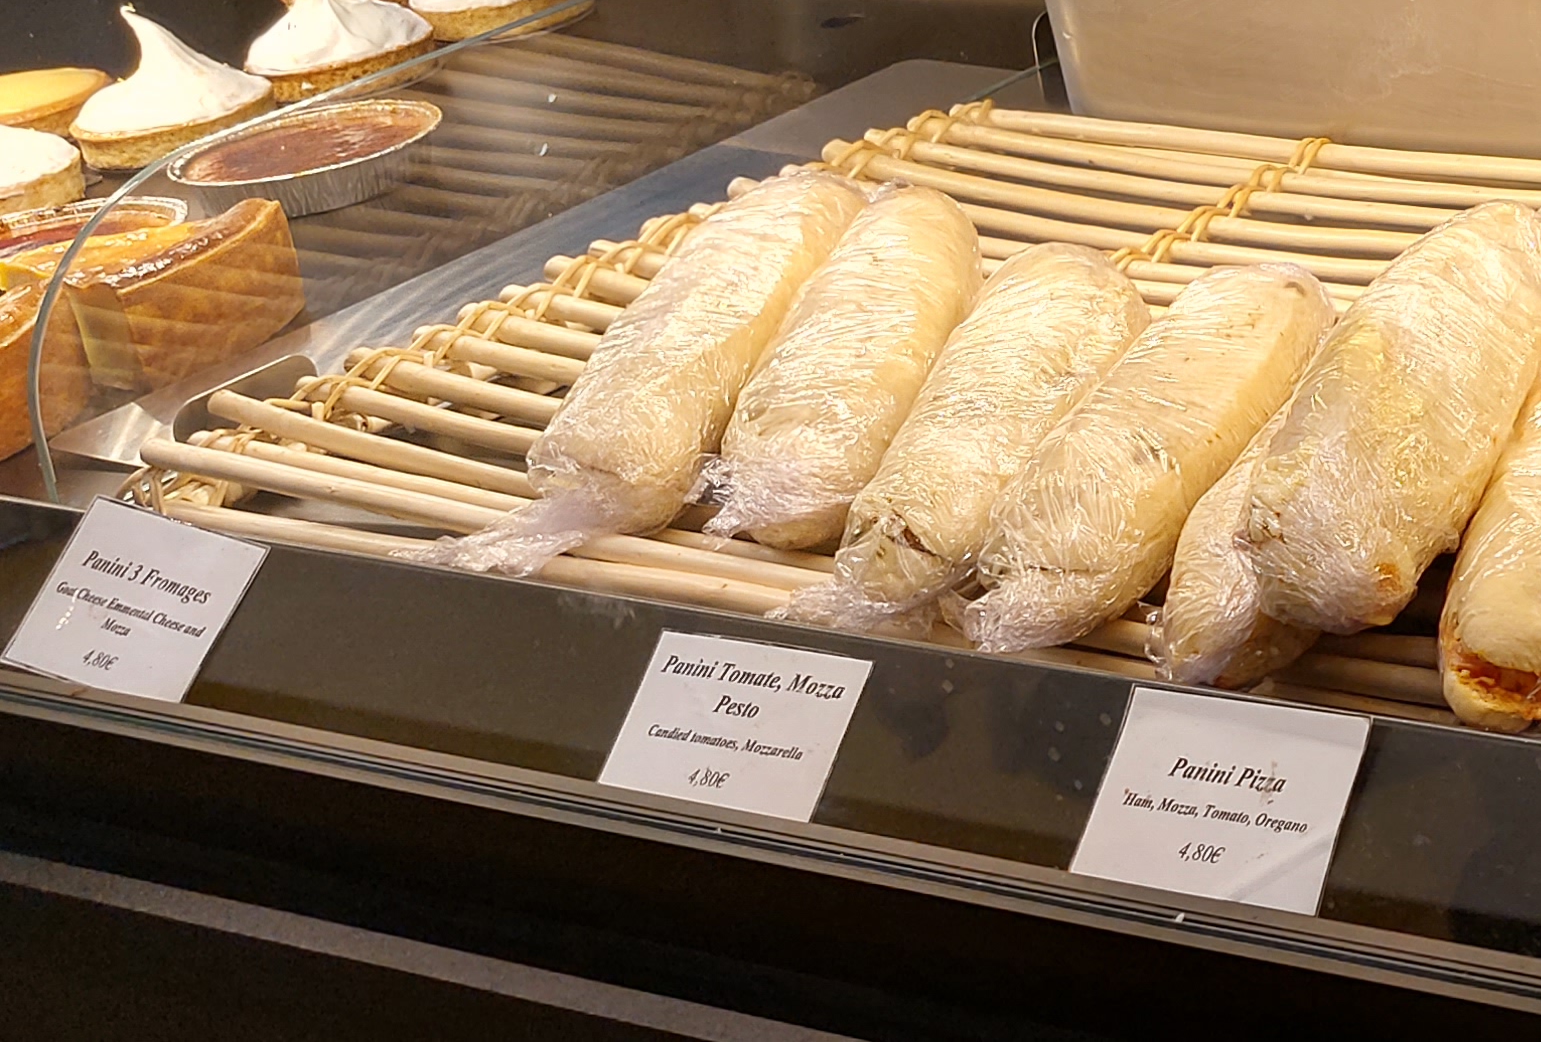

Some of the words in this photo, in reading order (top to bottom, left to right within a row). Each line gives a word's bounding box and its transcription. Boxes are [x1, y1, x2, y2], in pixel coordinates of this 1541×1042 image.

[82, 550, 132, 579] Panini
[128, 564, 144, 582] 3
[140, 568, 212, 604] Fromages
[76, 588, 107, 607] Cheese
[106, 598, 153, 621] Emmental
[152, 612, 186, 632] Cheese
[184, 624, 207, 638] and
[100, 617, 132, 637] Mozza
[82, 649, 120, 671] 4,80€
[660, 654, 719, 680] Panini
[717, 661, 782, 693] Tomate,
[786, 672, 846, 700] Mozza
[712, 695, 761, 719] Pesto
[647, 723, 693, 742] Candied
[690, 731, 739, 751] tomatoes,
[741, 739, 804, 761] Mozzarella
[688, 768, 730, 789] 4,80€
[1168, 756, 1236, 785] Panini
[1234, 767, 1288, 794] Pizza
[1122, 791, 1155, 812] Ham,
[1156, 797, 1199, 818] Mozza,
[1202, 804, 1251, 826] Tomato,
[1254, 812, 1308, 834] Oregano
[1178, 841, 1226, 865] 4,80€
